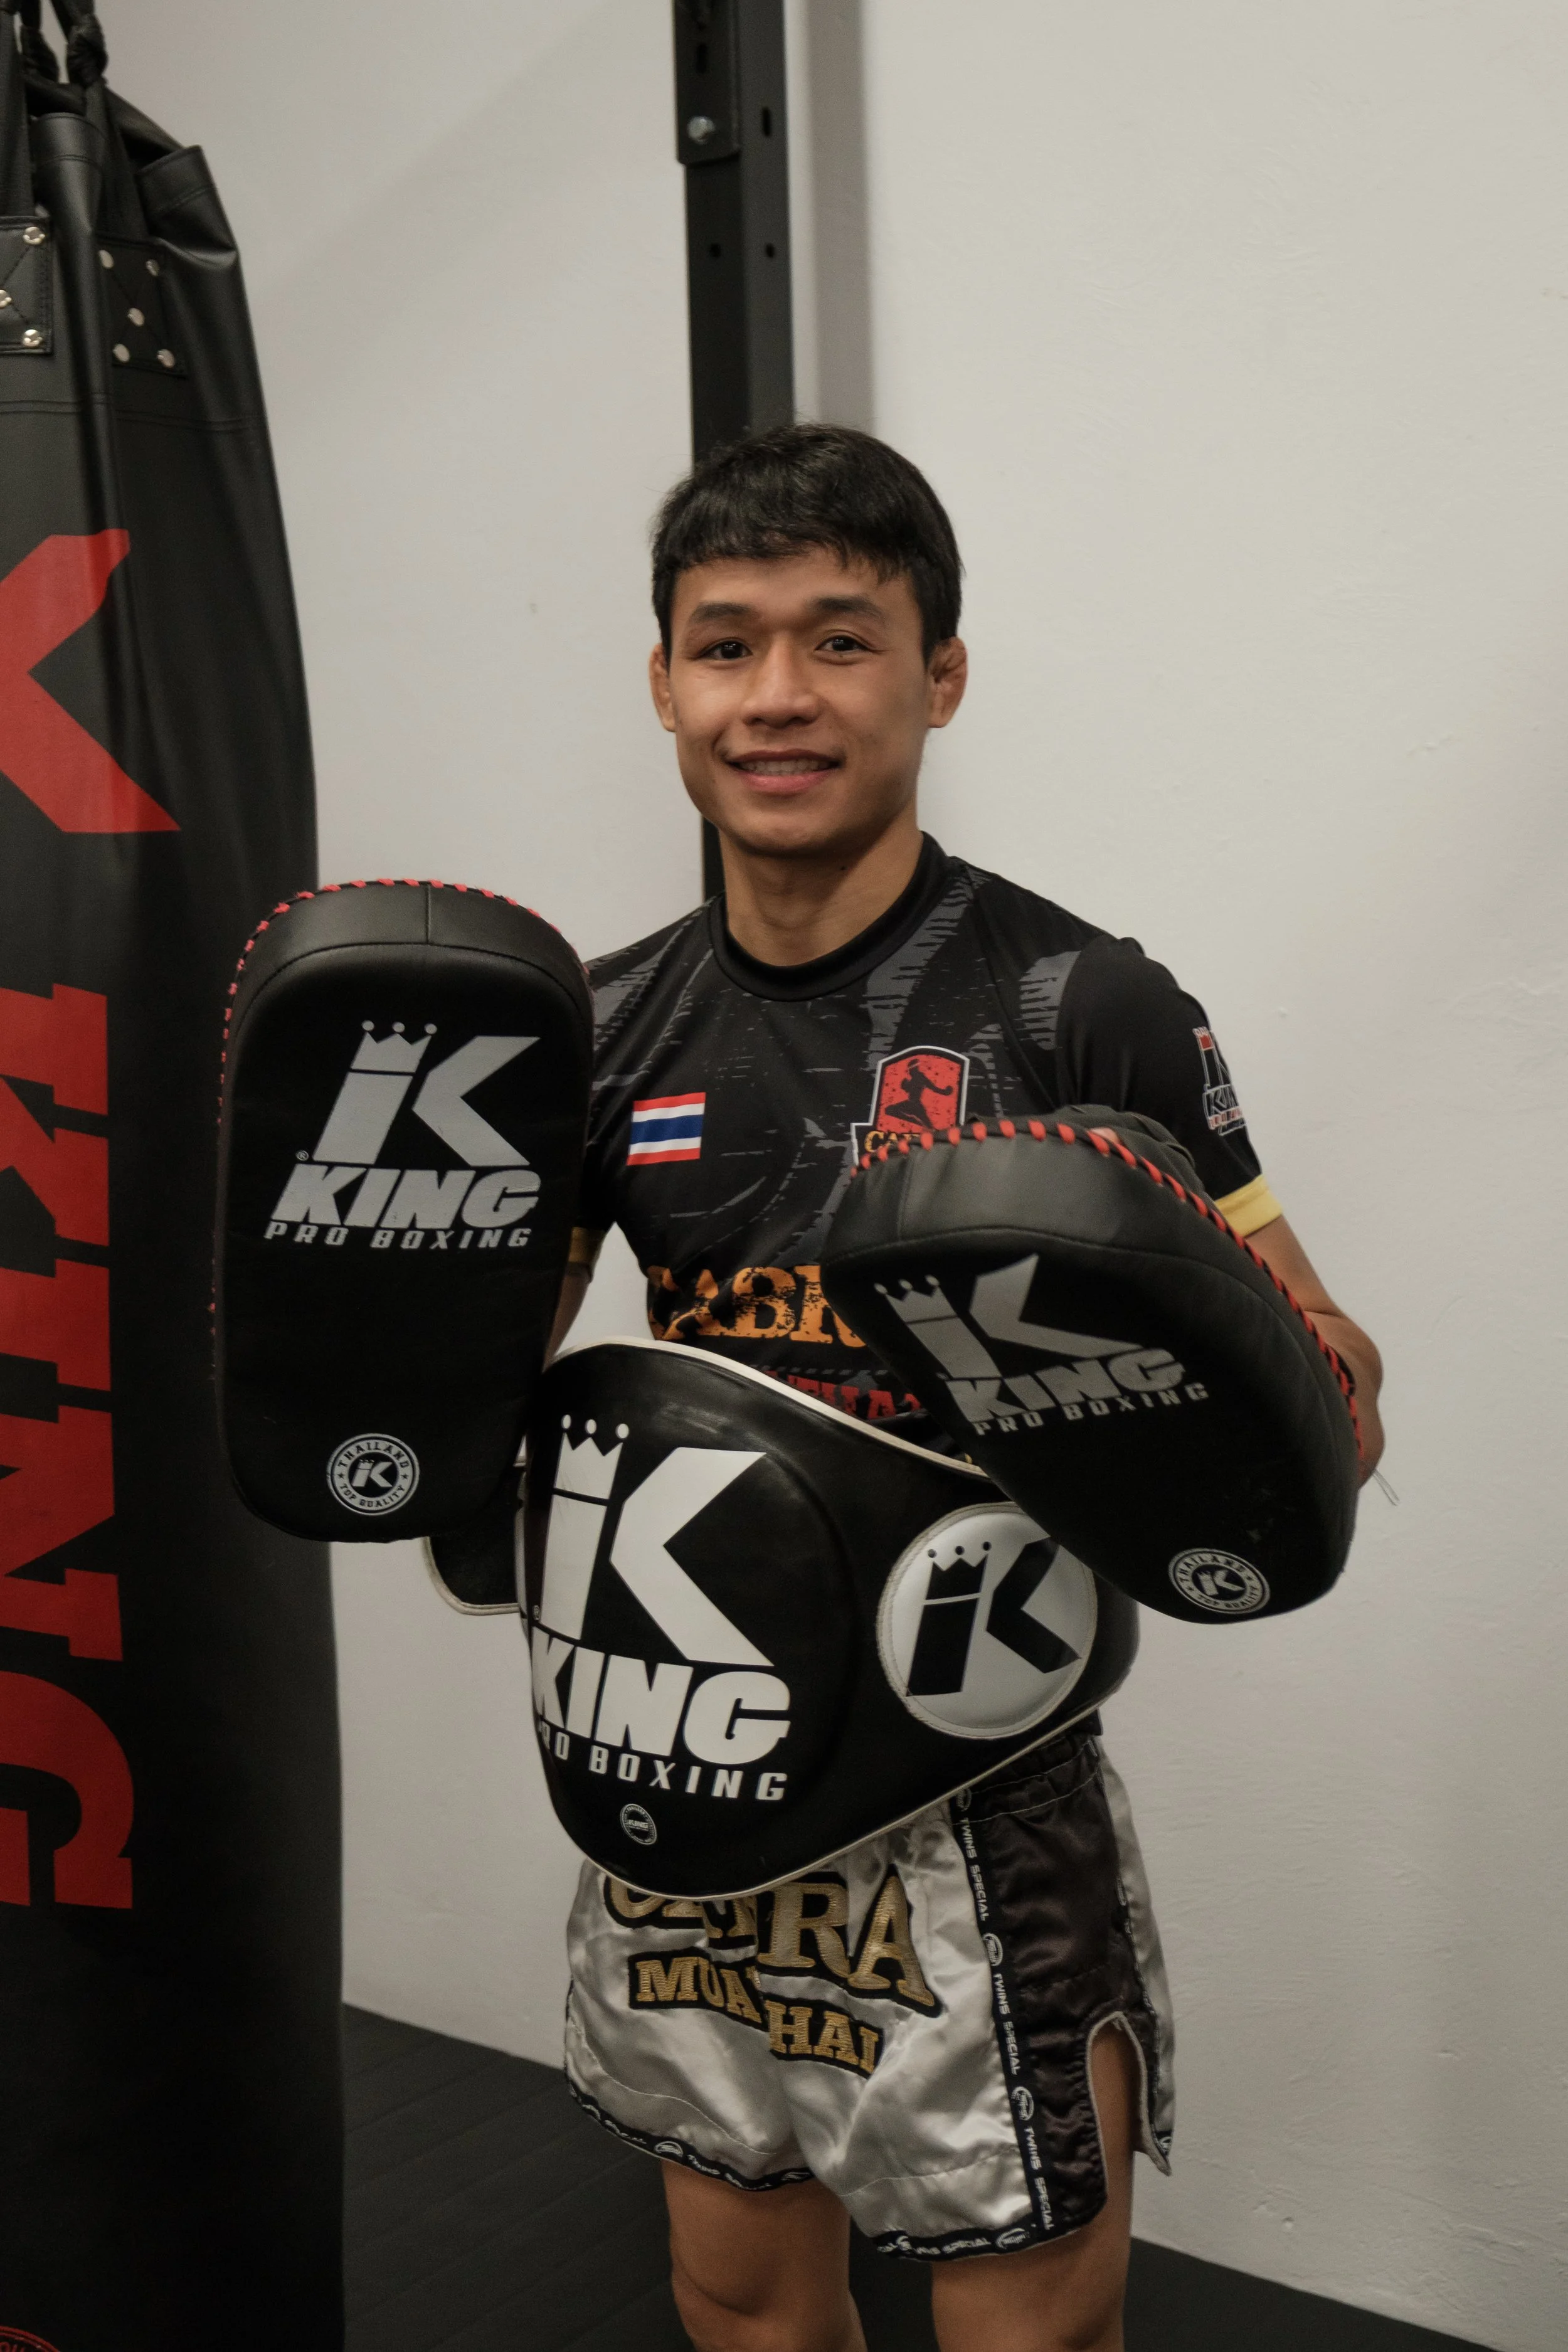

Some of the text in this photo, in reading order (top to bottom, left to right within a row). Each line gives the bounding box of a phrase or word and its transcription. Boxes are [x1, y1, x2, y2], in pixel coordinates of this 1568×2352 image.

[270, 1163, 542, 1229] KING
[263, 1221, 532, 1250] PRO BOXING
[945, 1347, 1187, 1424] KING
[973, 1382, 1210, 1436] PRO BOXING
[337, 1441, 409, 1469] THAILAND
[340, 1483, 405, 1508] TOP QUALITY
[532, 1626, 792, 1764] KING
[588, 1744, 788, 1801] BOXING
[960, 1816, 978, 1859] TWINS
[970, 1864, 990, 1922] SPECIAL
[764, 2000, 879, 2074] HAI
[993, 1973, 1011, 2015] TWINS
[1003, 2021, 1022, 2075] SPECIAL
[1034, 2176, 1056, 2230] SPECIAL
